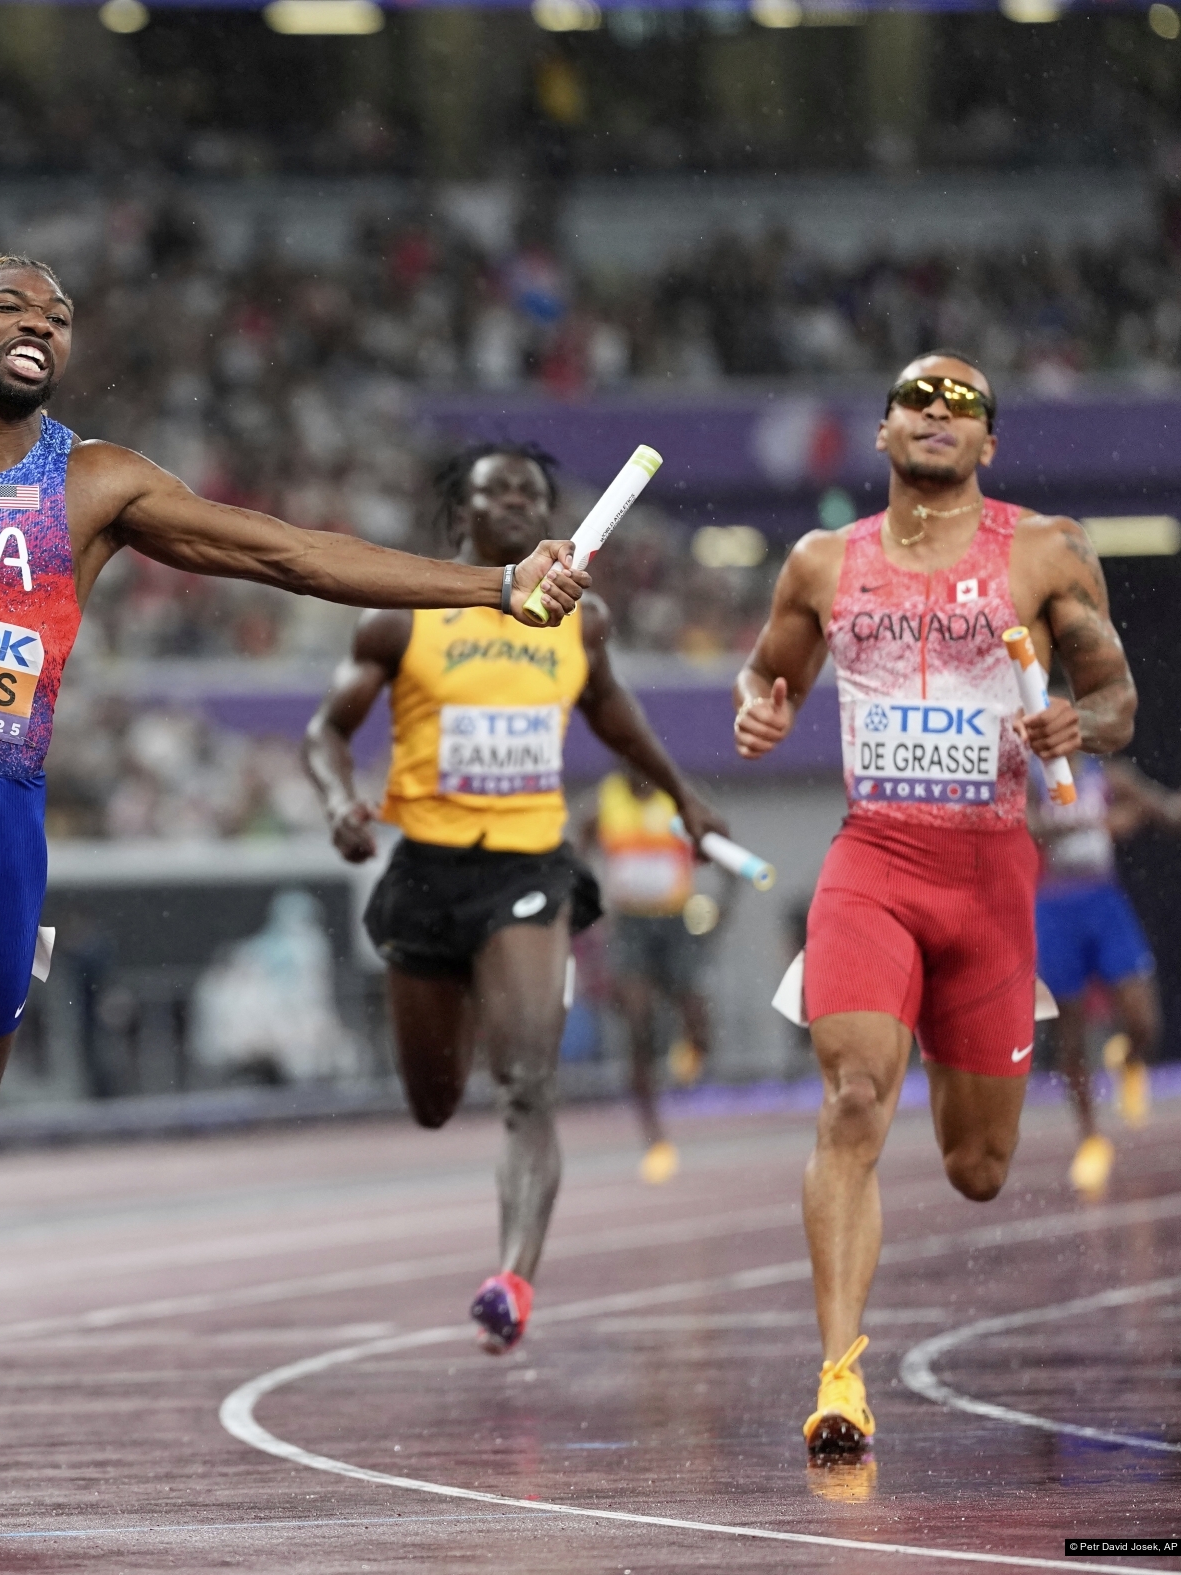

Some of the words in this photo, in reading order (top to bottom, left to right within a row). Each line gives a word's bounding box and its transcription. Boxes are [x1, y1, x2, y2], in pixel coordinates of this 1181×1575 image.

[851, 611, 995, 642] CANADA
[480, 711, 552, 736] TDK
[890, 706, 986, 736] TDK
[861, 742, 886, 770] DE
[893, 743, 990, 775] GRASSE
